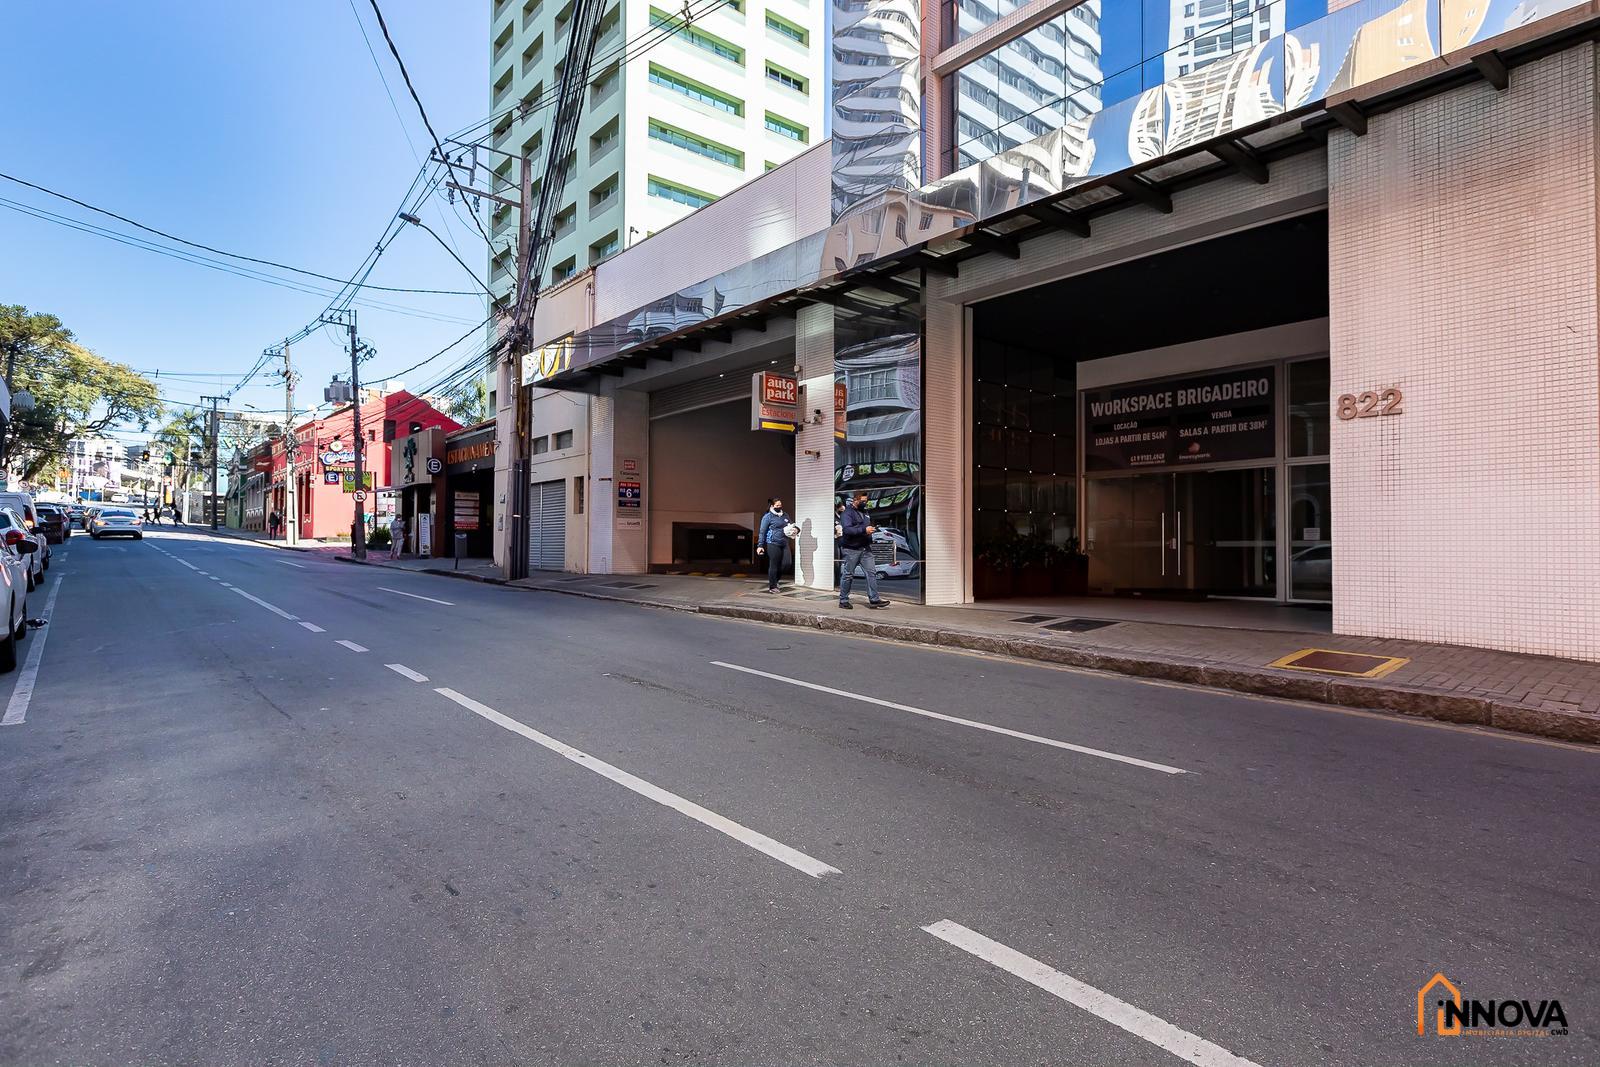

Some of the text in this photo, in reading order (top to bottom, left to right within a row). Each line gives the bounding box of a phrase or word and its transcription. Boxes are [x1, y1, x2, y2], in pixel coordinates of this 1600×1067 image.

[767, 378, 794, 390] auto
[767, 388, 795, 401] park
[1090, 377, 1269, 418] WORKSPACE BRIGADEIRO
[1335, 387, 1404, 421] 822
[1211, 410, 1232, 420] VENDA
[1113, 421, 1138, 432] LOCAÇÃO
[1179, 426, 1202, 438] SALAS
[1202, 427, 1208, 436] A
[1211, 424, 1237, 434] PARTIR
[1238, 422, 1248, 432] DE
[1096, 434, 1114, 446] LOJAS
[1114, 435, 1120, 444] A
[1120, 434, 1142, 444] PARTIR
[1142, 432, 1152, 441] DE
